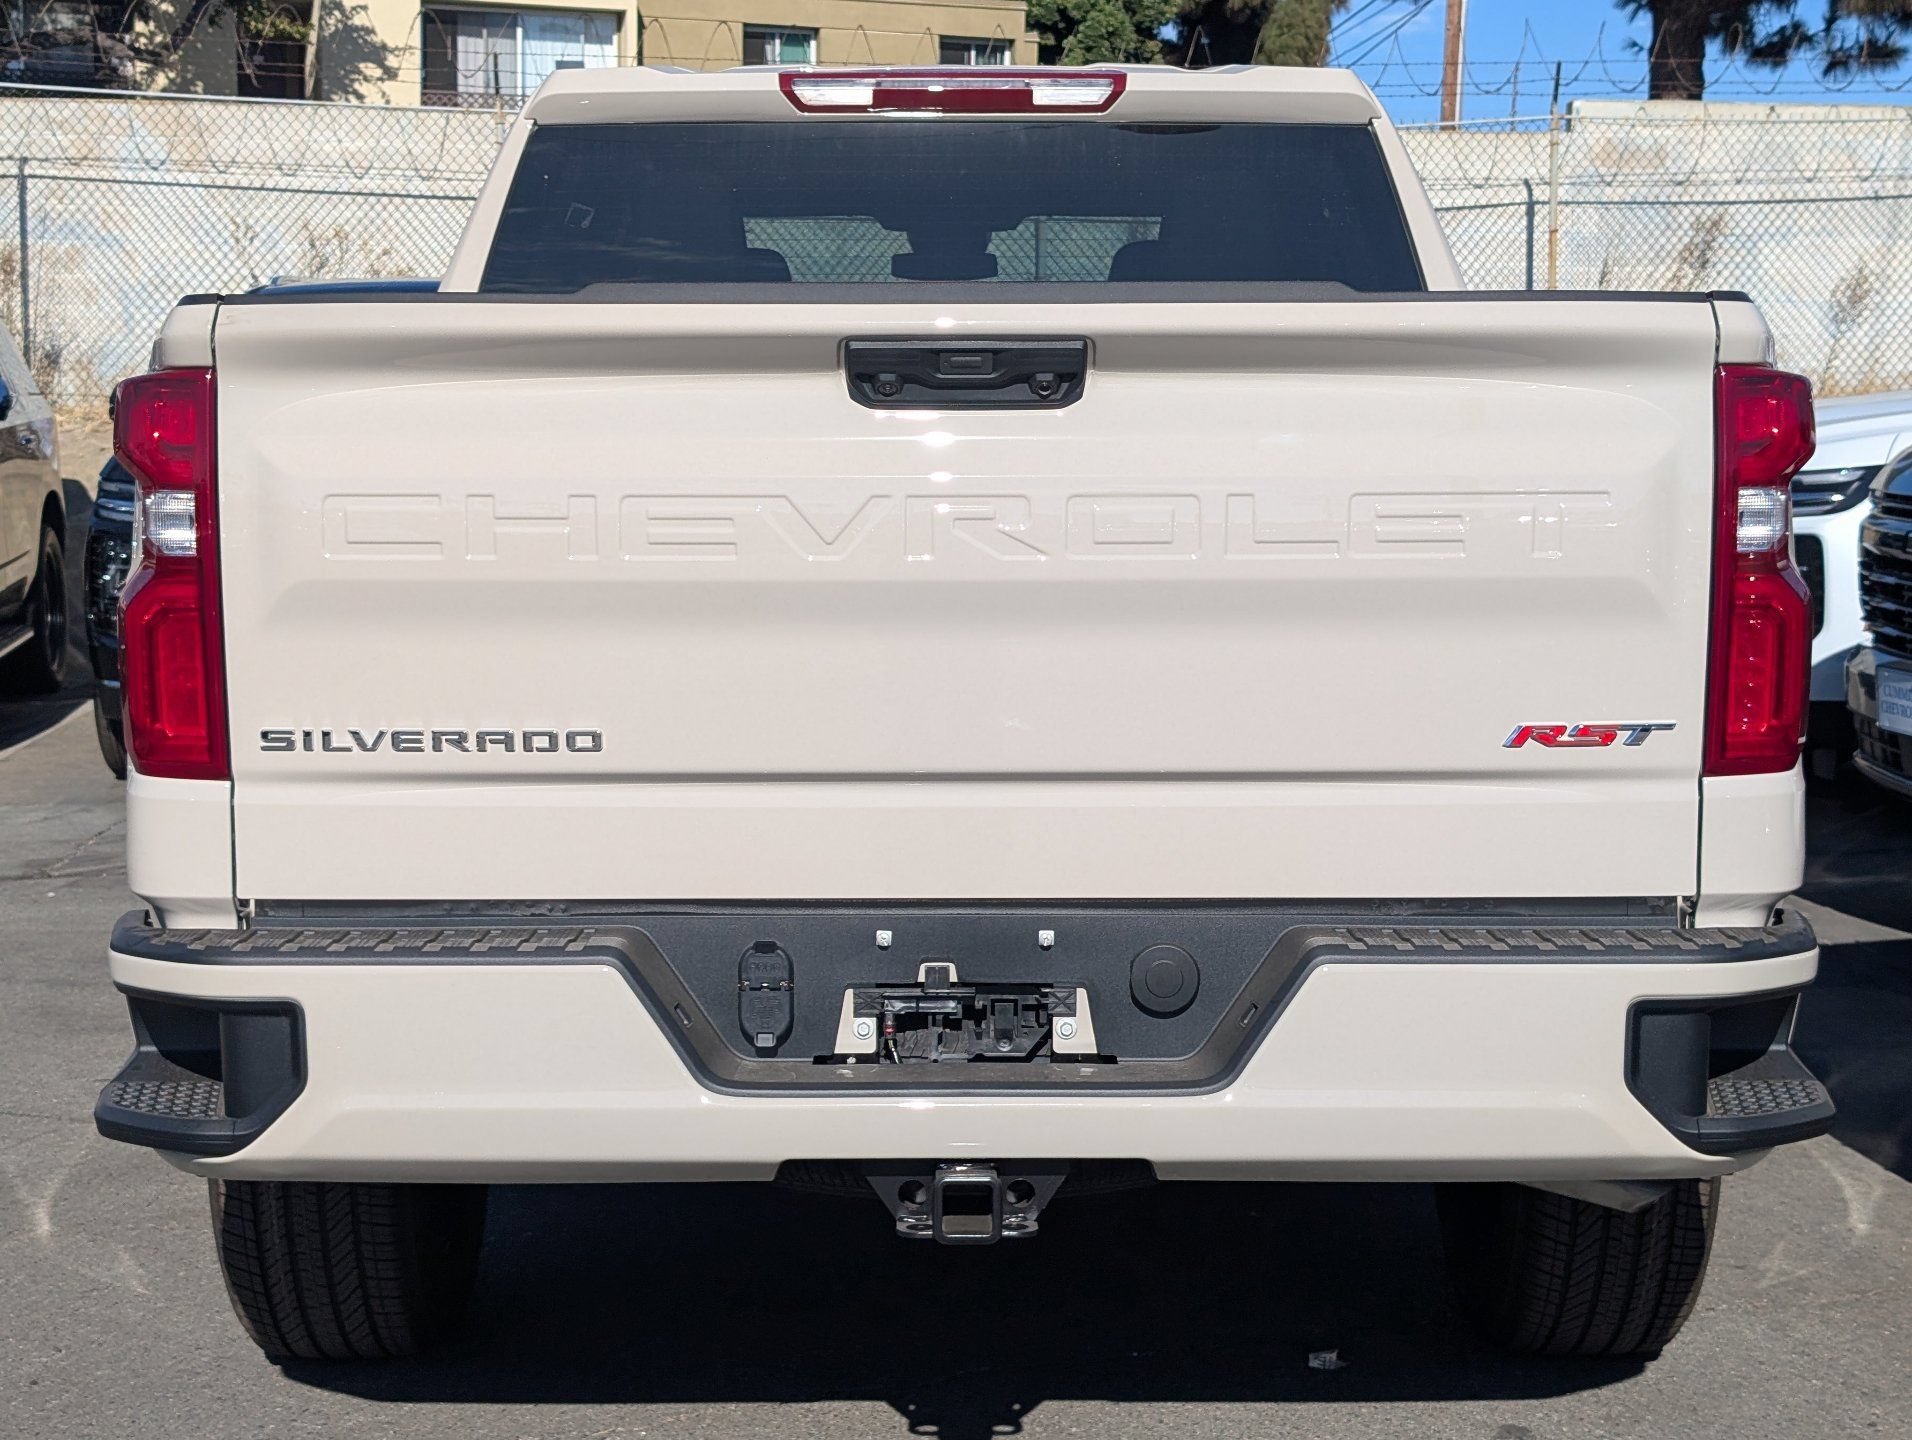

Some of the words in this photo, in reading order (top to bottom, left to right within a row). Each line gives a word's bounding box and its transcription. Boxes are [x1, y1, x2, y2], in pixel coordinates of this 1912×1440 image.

[322, 490, 1612, 561] CHEVROLET
[259, 728, 604, 753] SILVERADO
[1501, 721, 1677, 749] RST
